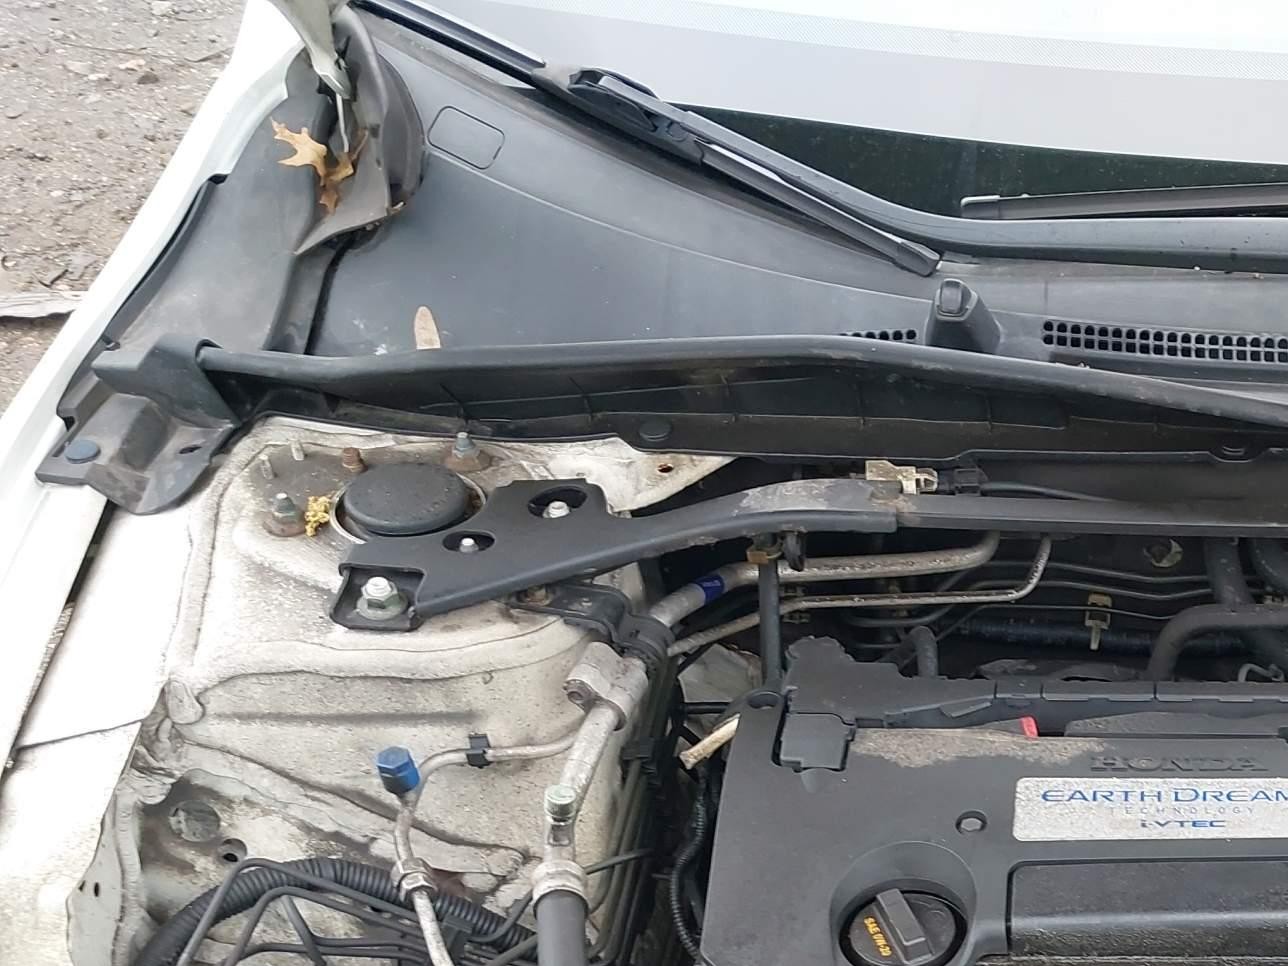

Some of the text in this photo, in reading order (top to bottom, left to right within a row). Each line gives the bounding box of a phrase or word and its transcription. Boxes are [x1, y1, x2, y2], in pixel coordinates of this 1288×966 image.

[1089, 756, 1269, 772] HONDA
[1041, 790, 1162, 802] EARTH
[1109, 806, 1254, 815] TECHNOLOGY
